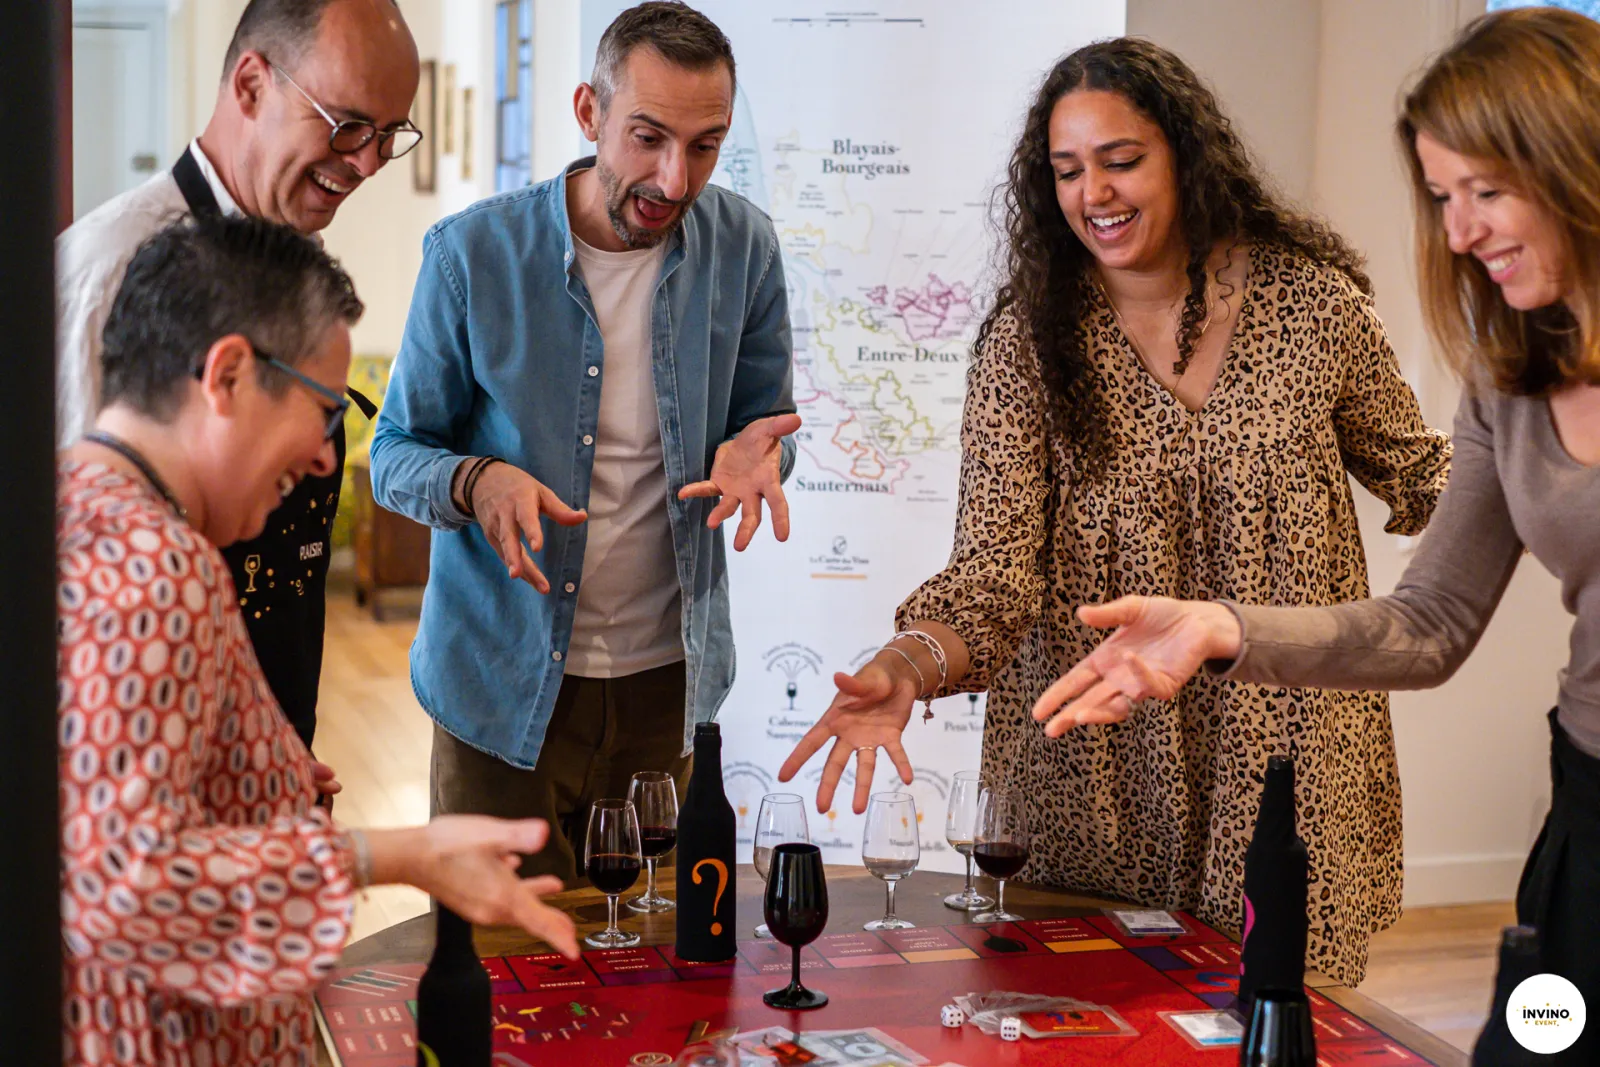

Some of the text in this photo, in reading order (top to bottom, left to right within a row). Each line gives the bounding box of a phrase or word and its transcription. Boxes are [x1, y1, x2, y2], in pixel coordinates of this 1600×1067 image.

[822, 158, 910, 180] Bourgeais
[857, 346, 965, 362] Entre-Deux-
[796, 476, 889, 493] Sauternais
[691, 858, 729, 936] ?
